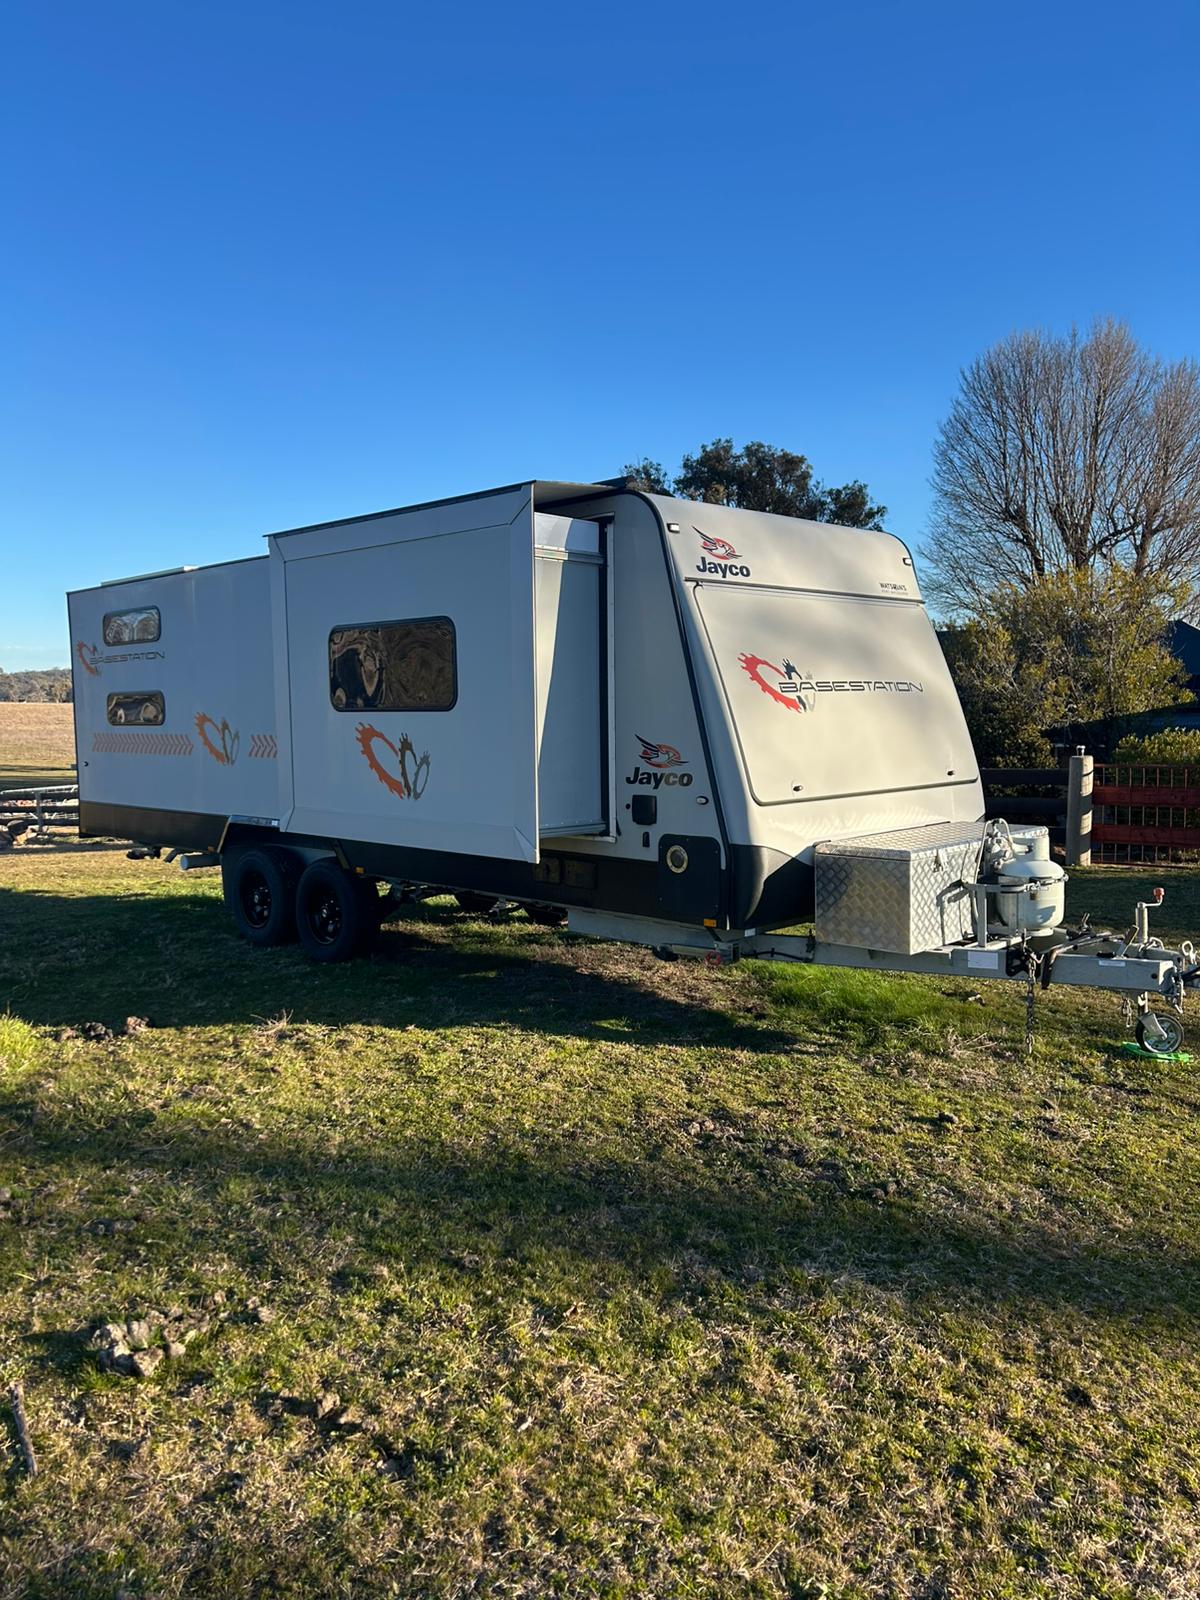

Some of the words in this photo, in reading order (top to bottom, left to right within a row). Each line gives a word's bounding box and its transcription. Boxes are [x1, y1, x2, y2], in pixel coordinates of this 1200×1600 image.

[695, 556, 751, 578] Jayco
[90, 652, 165, 664] BASESTATION
[778, 680, 924, 692] BASESTATION
[626, 767, 693, 789] Jayco
